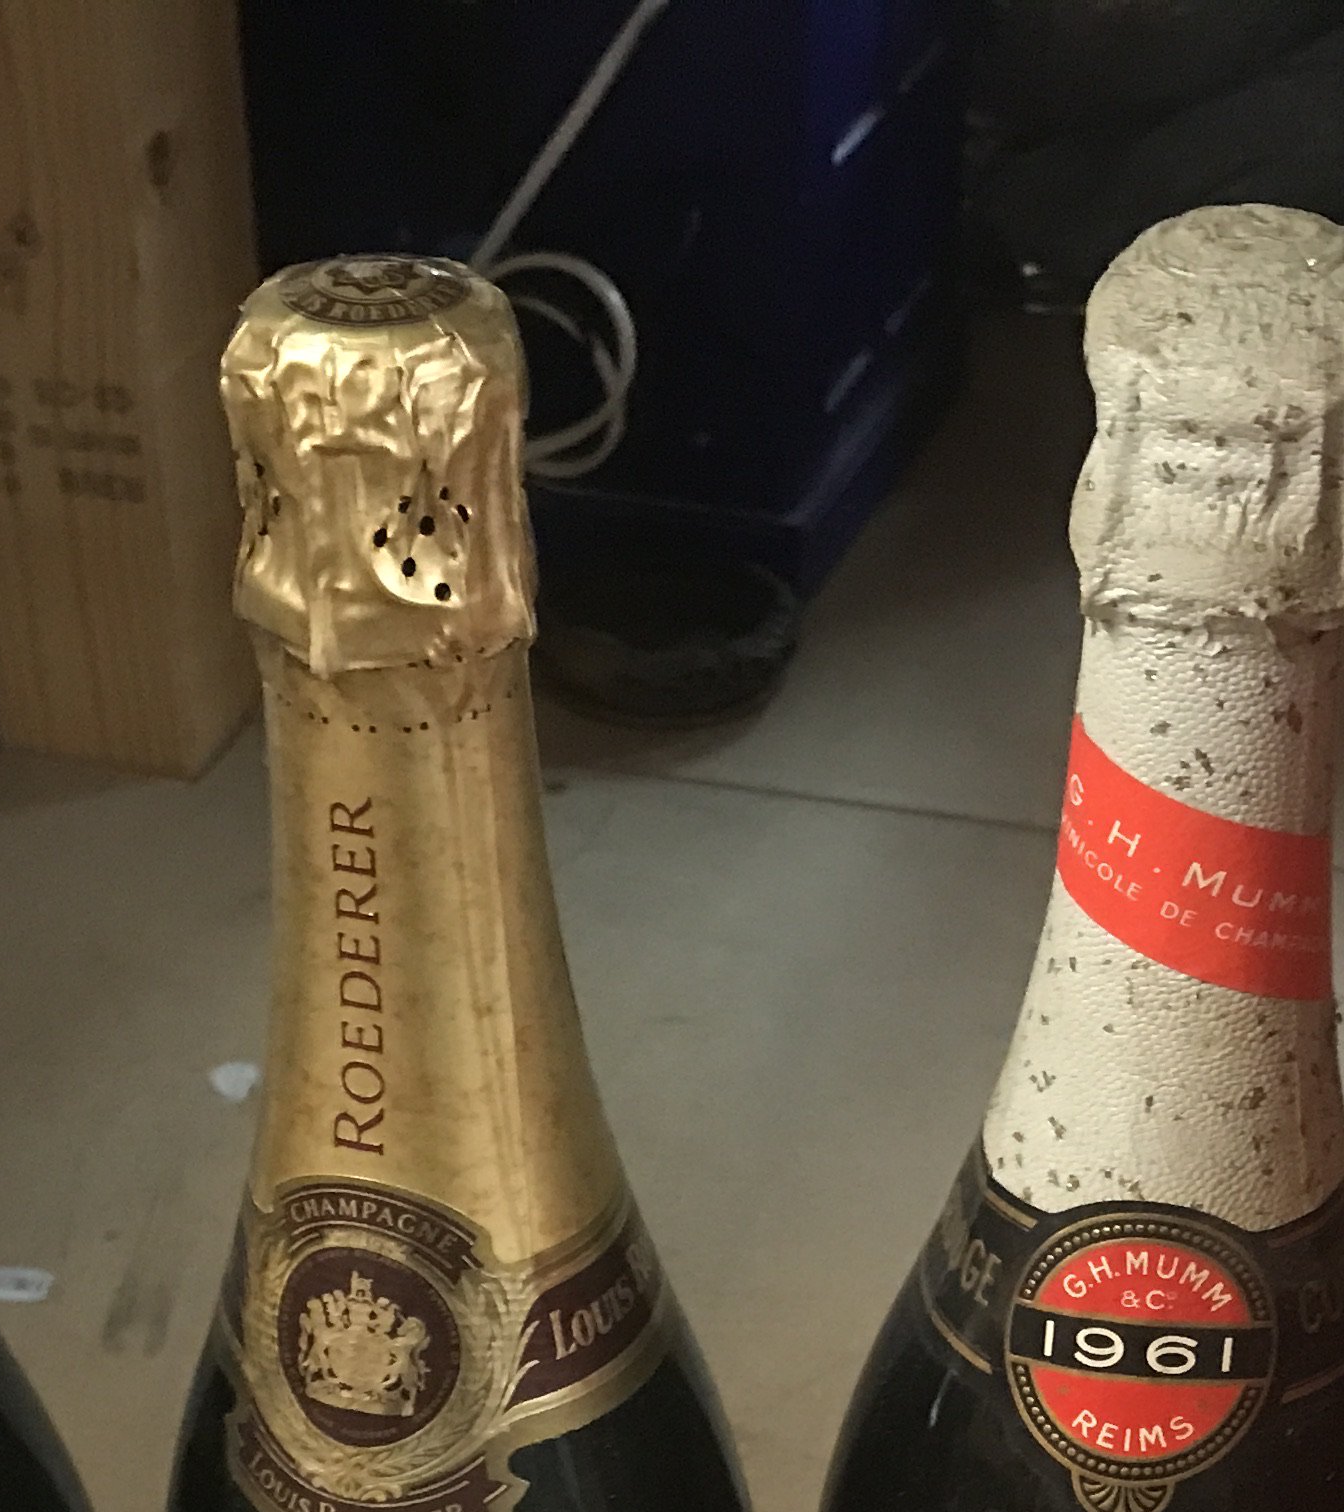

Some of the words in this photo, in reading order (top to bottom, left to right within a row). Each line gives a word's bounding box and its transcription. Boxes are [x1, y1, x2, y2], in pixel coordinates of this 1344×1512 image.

[1159, 901, 1198, 928] DE
[329, 797, 385, 1156] ROEDERER
[290, 1197, 457, 1254] CHAMPAGNE
[1061, 1250, 1234, 1313] G.H.MUMM
[1042, 1319, 1234, 1375] 1961
[1071, 1408, 1195, 1453] REIMS
